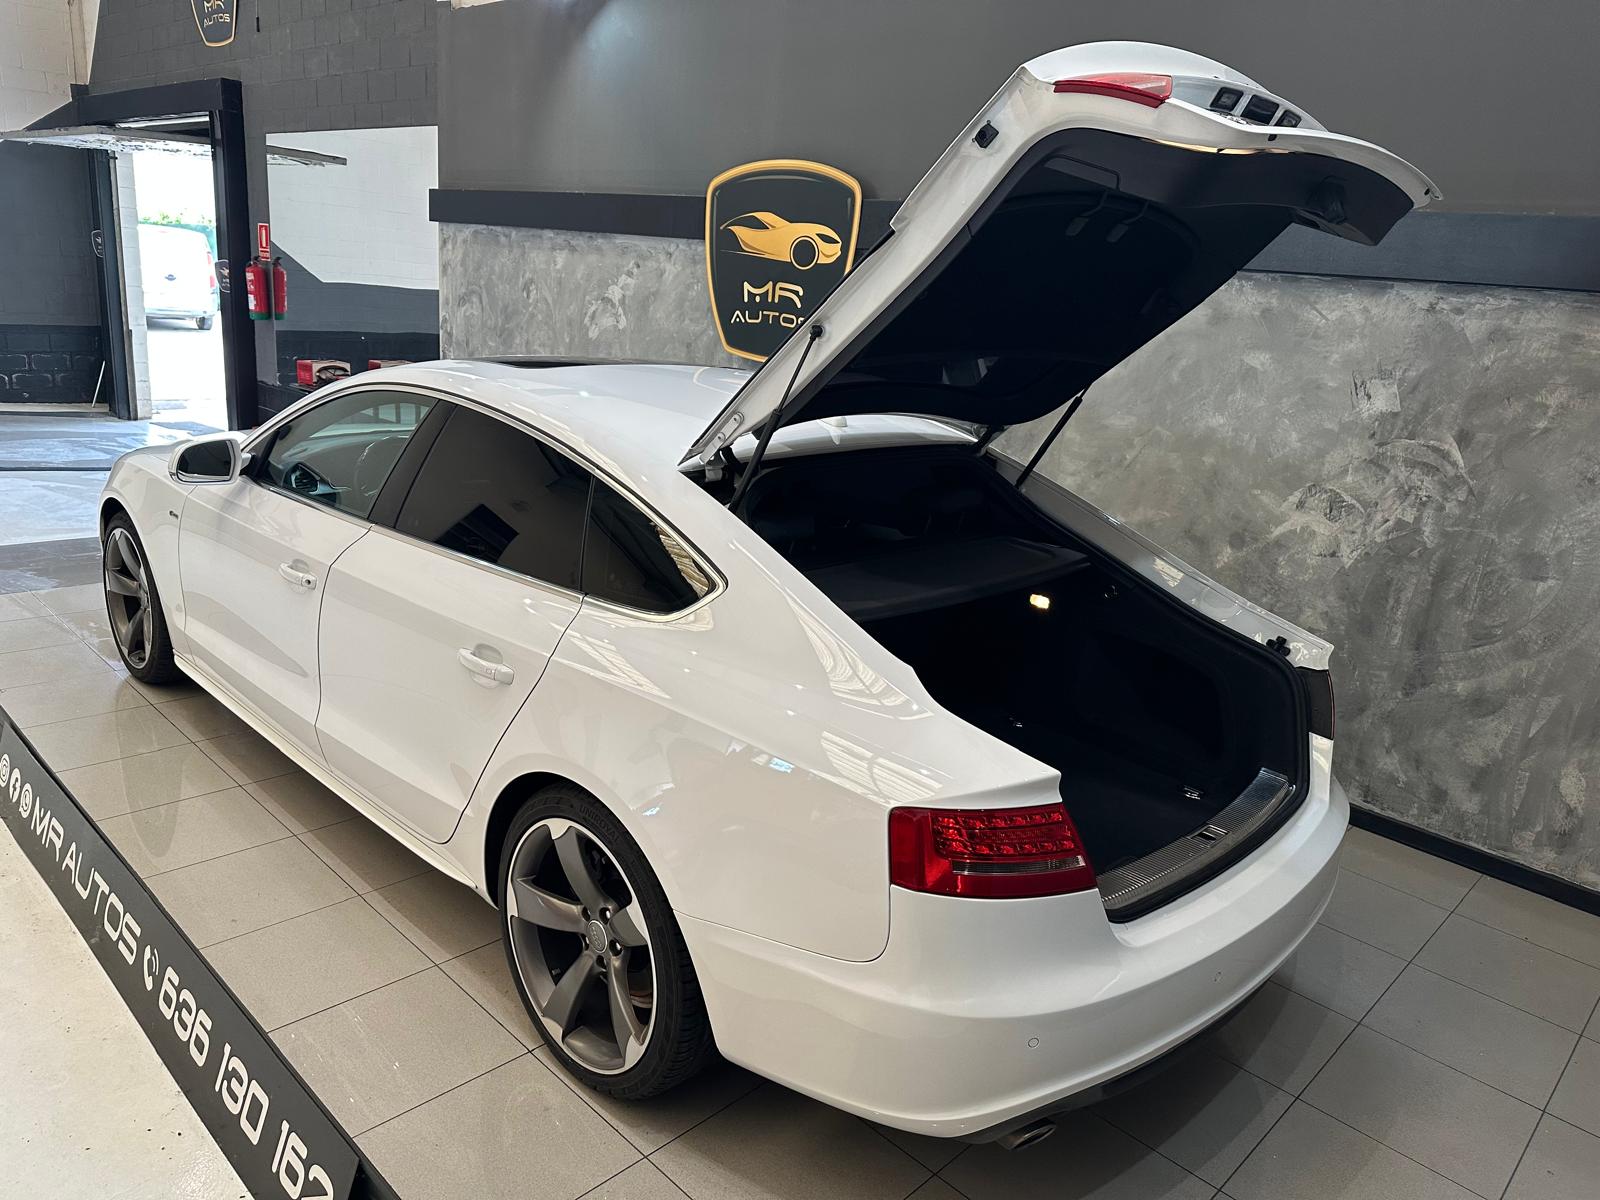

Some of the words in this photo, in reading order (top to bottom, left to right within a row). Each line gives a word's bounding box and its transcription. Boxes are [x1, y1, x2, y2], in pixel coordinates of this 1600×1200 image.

[203, 13, 231, 28] AUTOS
[743, 281, 804, 309] MR
[579, 806, 622, 843] UNIROYAL
[31, 796, 64, 862] MR
[62, 842, 141, 965] AUTOS
[158, 966, 212, 1067] 636
[214, 1043, 270, 1145] 130
